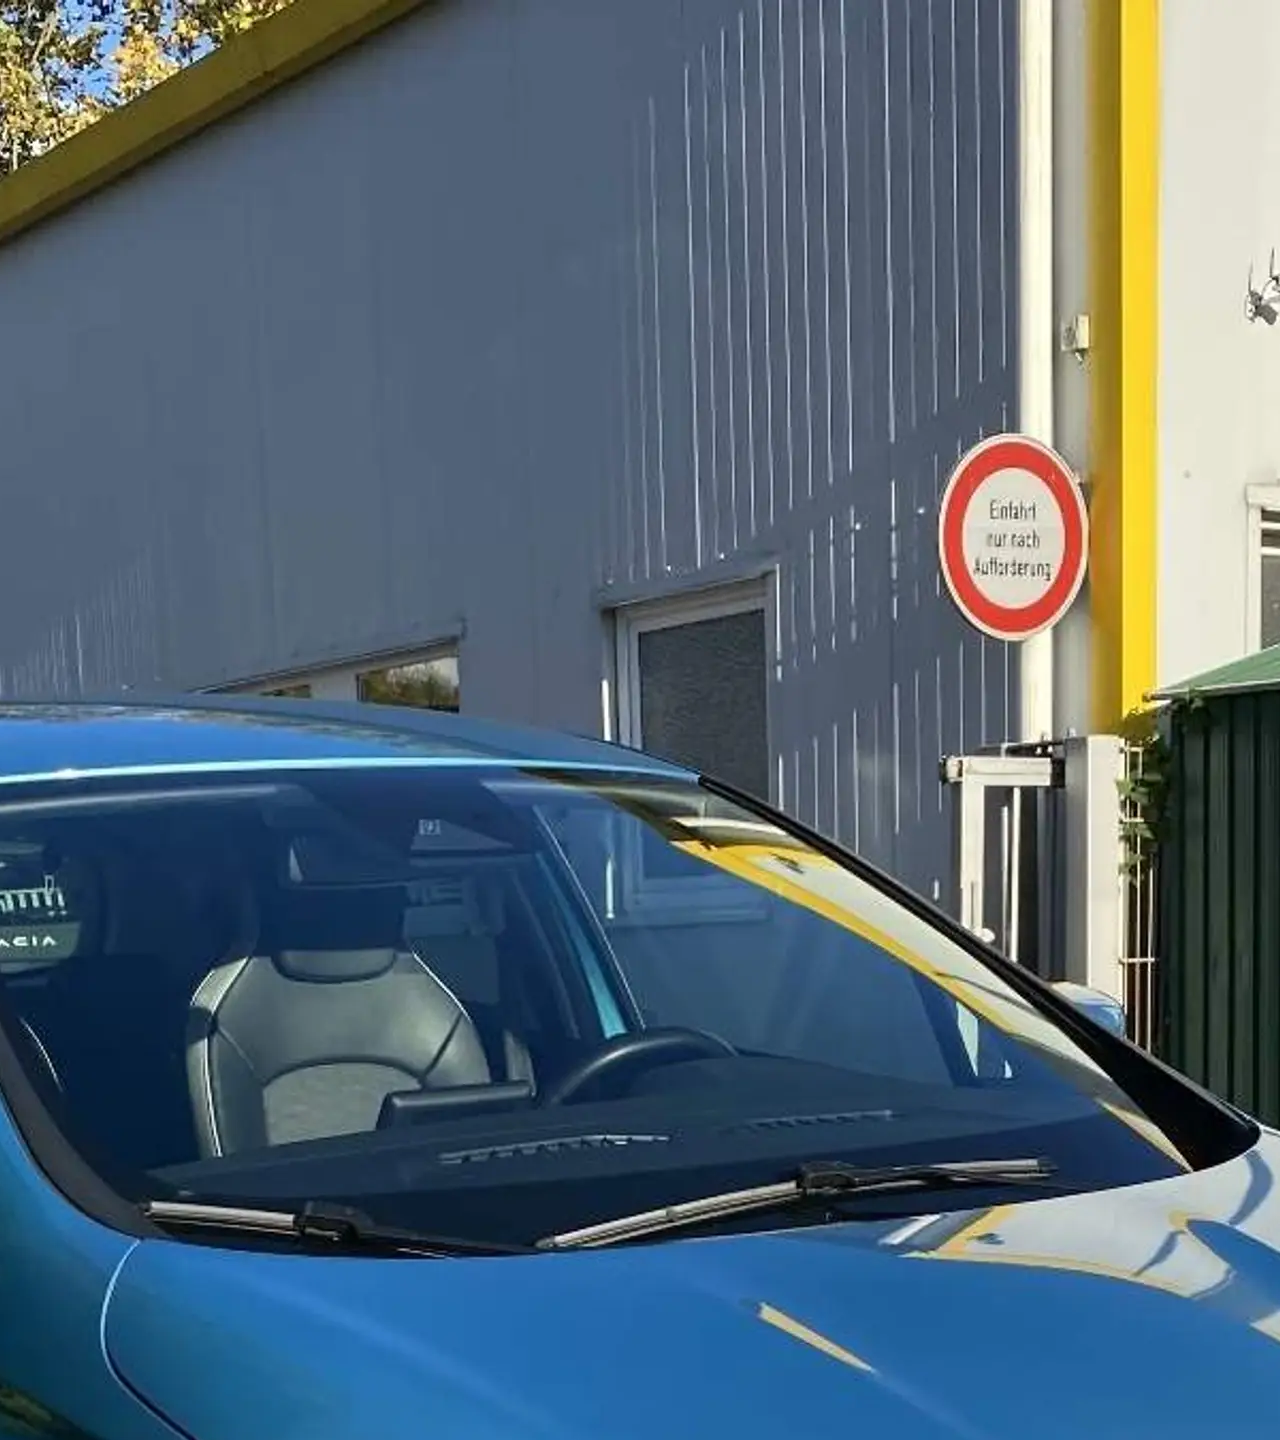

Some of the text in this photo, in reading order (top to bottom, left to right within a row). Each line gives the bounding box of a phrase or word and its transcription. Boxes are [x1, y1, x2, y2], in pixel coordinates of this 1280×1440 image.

[989, 499, 1037, 521] Einfahrt
[986, 529, 1040, 549] nur nach
[973, 557, 1051, 582] Aufforderung
